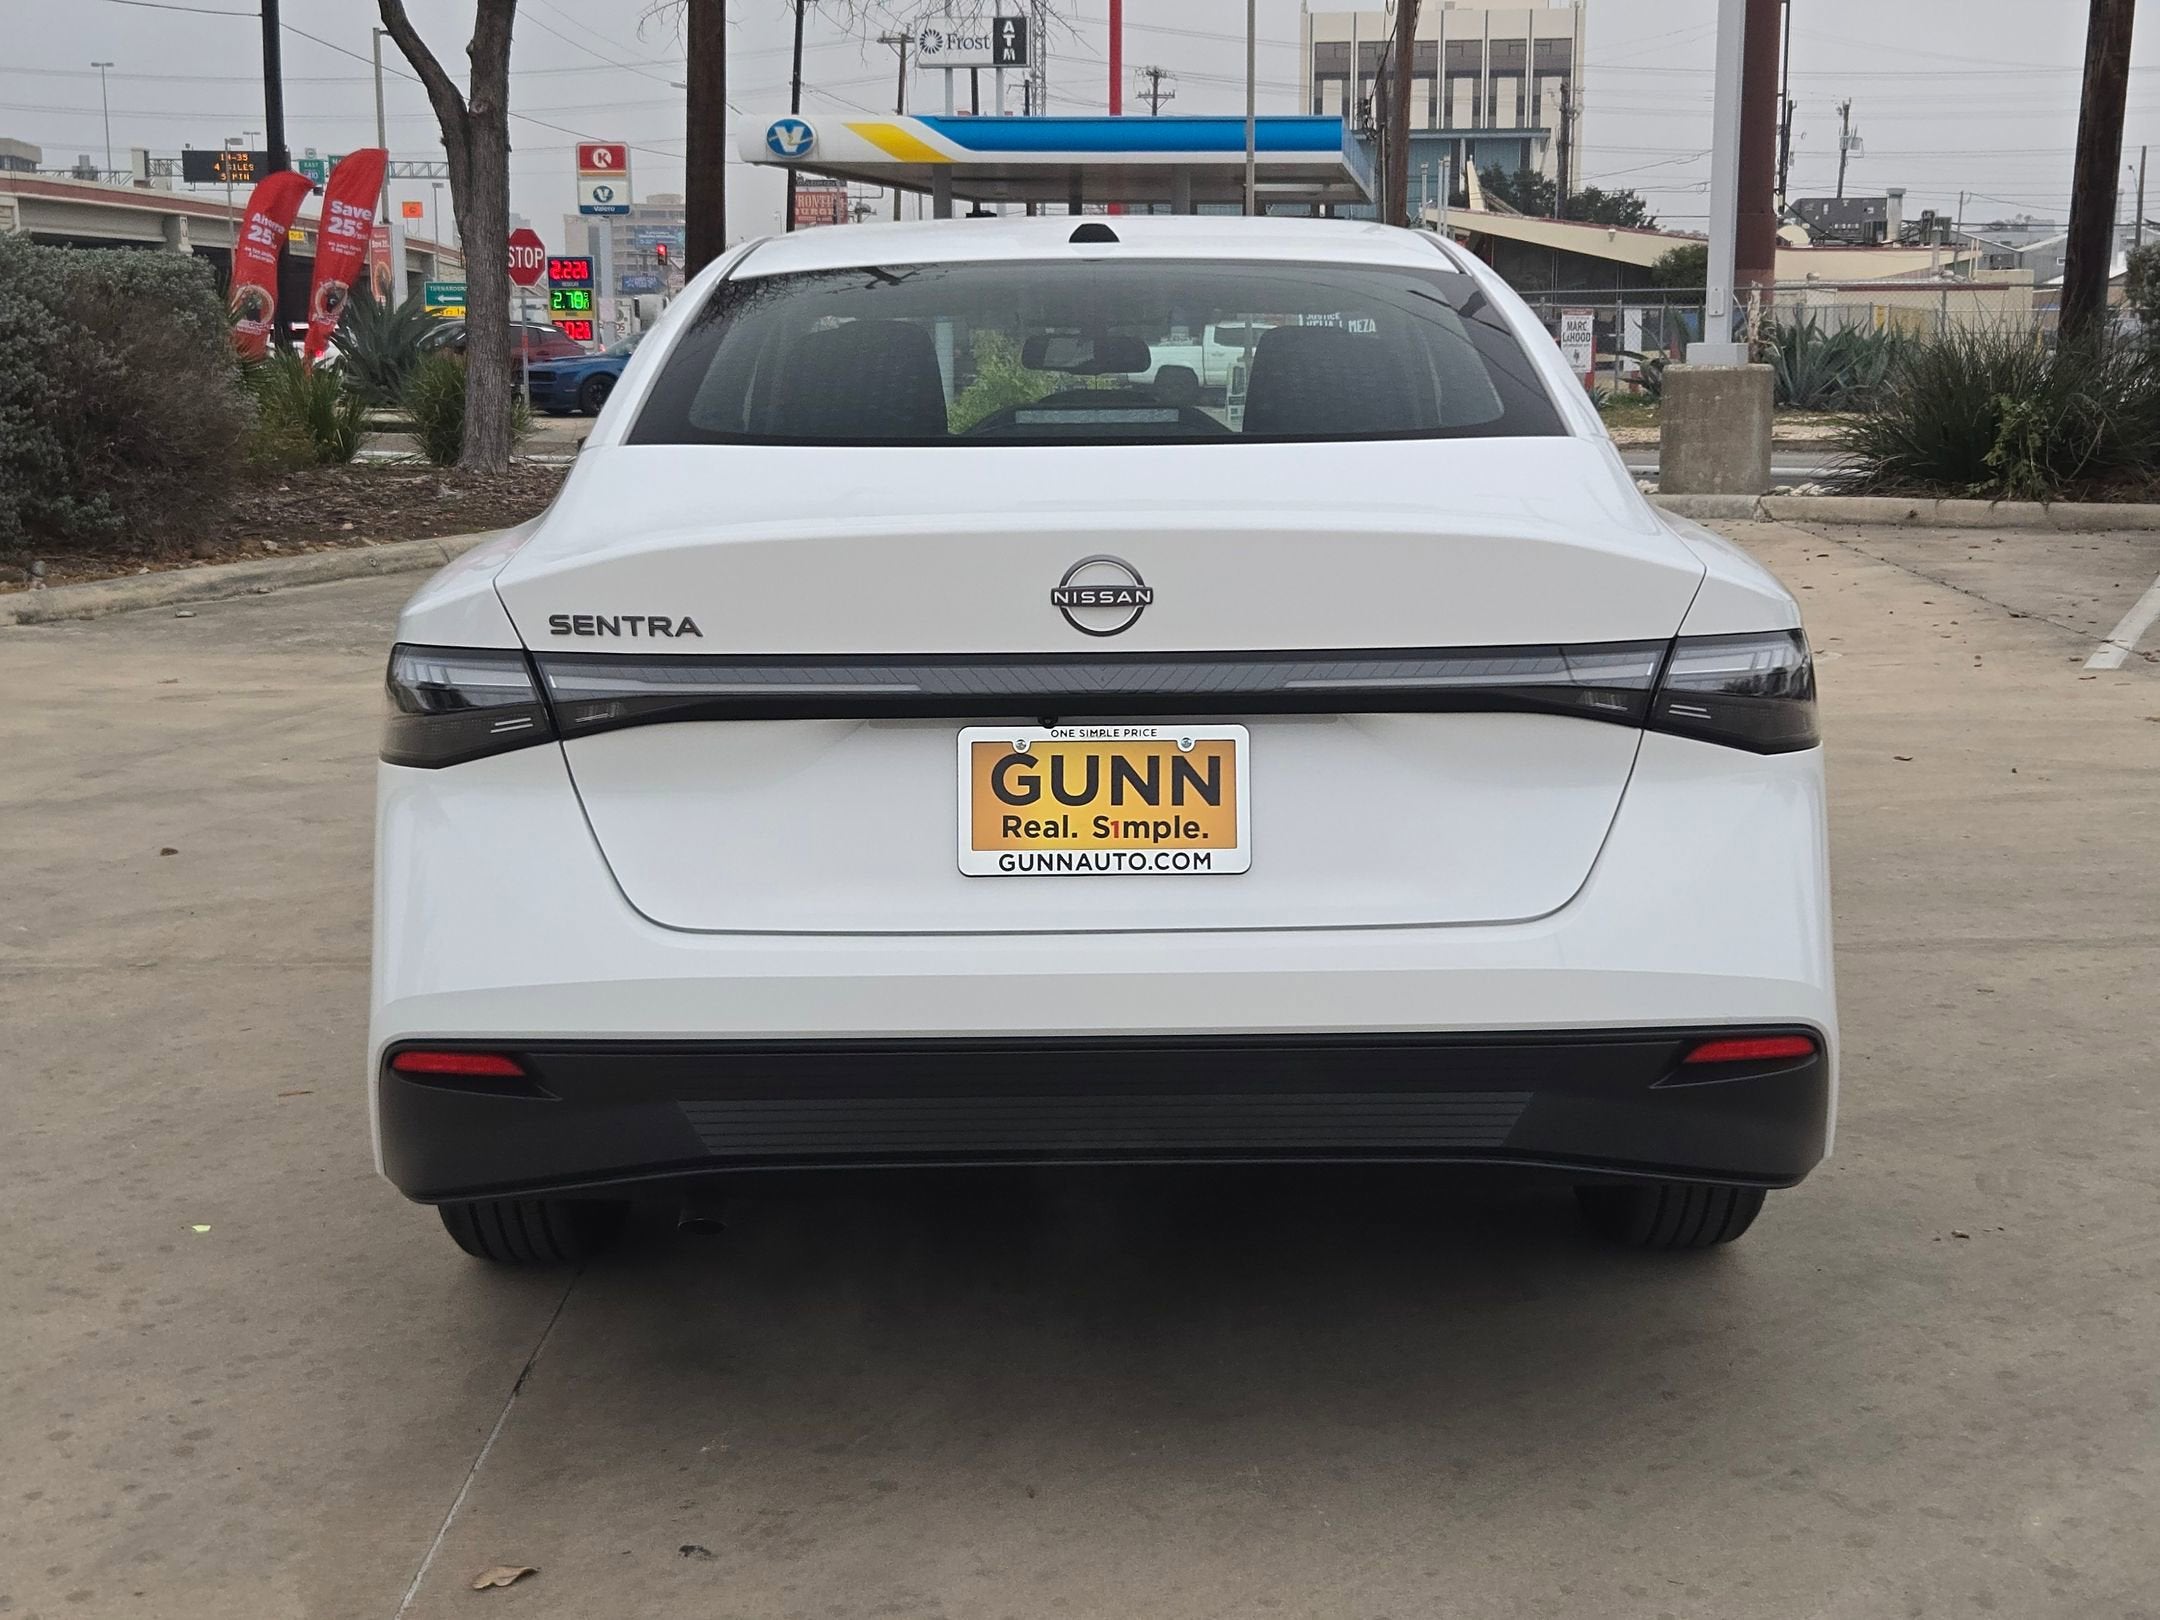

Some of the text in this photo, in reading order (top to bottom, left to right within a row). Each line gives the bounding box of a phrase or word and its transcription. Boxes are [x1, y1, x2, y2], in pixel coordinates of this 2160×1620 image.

[946, 33, 991, 50] Frost
[1002, 20, 1016, 60] ATM
[214, 163, 220, 171] 4
[331, 200, 373, 220] Save
[594, 205, 616, 213] Valero
[508, 246, 543, 269] STOP
[1348, 318, 1376, 333] MEZA
[1567, 320, 1588, 331] MARC
[1054, 590, 1151, 604] NISSAN
[548, 614, 704, 638] SENTRA
[1051, 728, 1157, 738] ONE SIMPLE PRICE
[991, 753, 1221, 807] GUNN
[1002, 815, 1078, 839] Real.
[998, 851, 1212, 872] GUNNAUTO.COM
